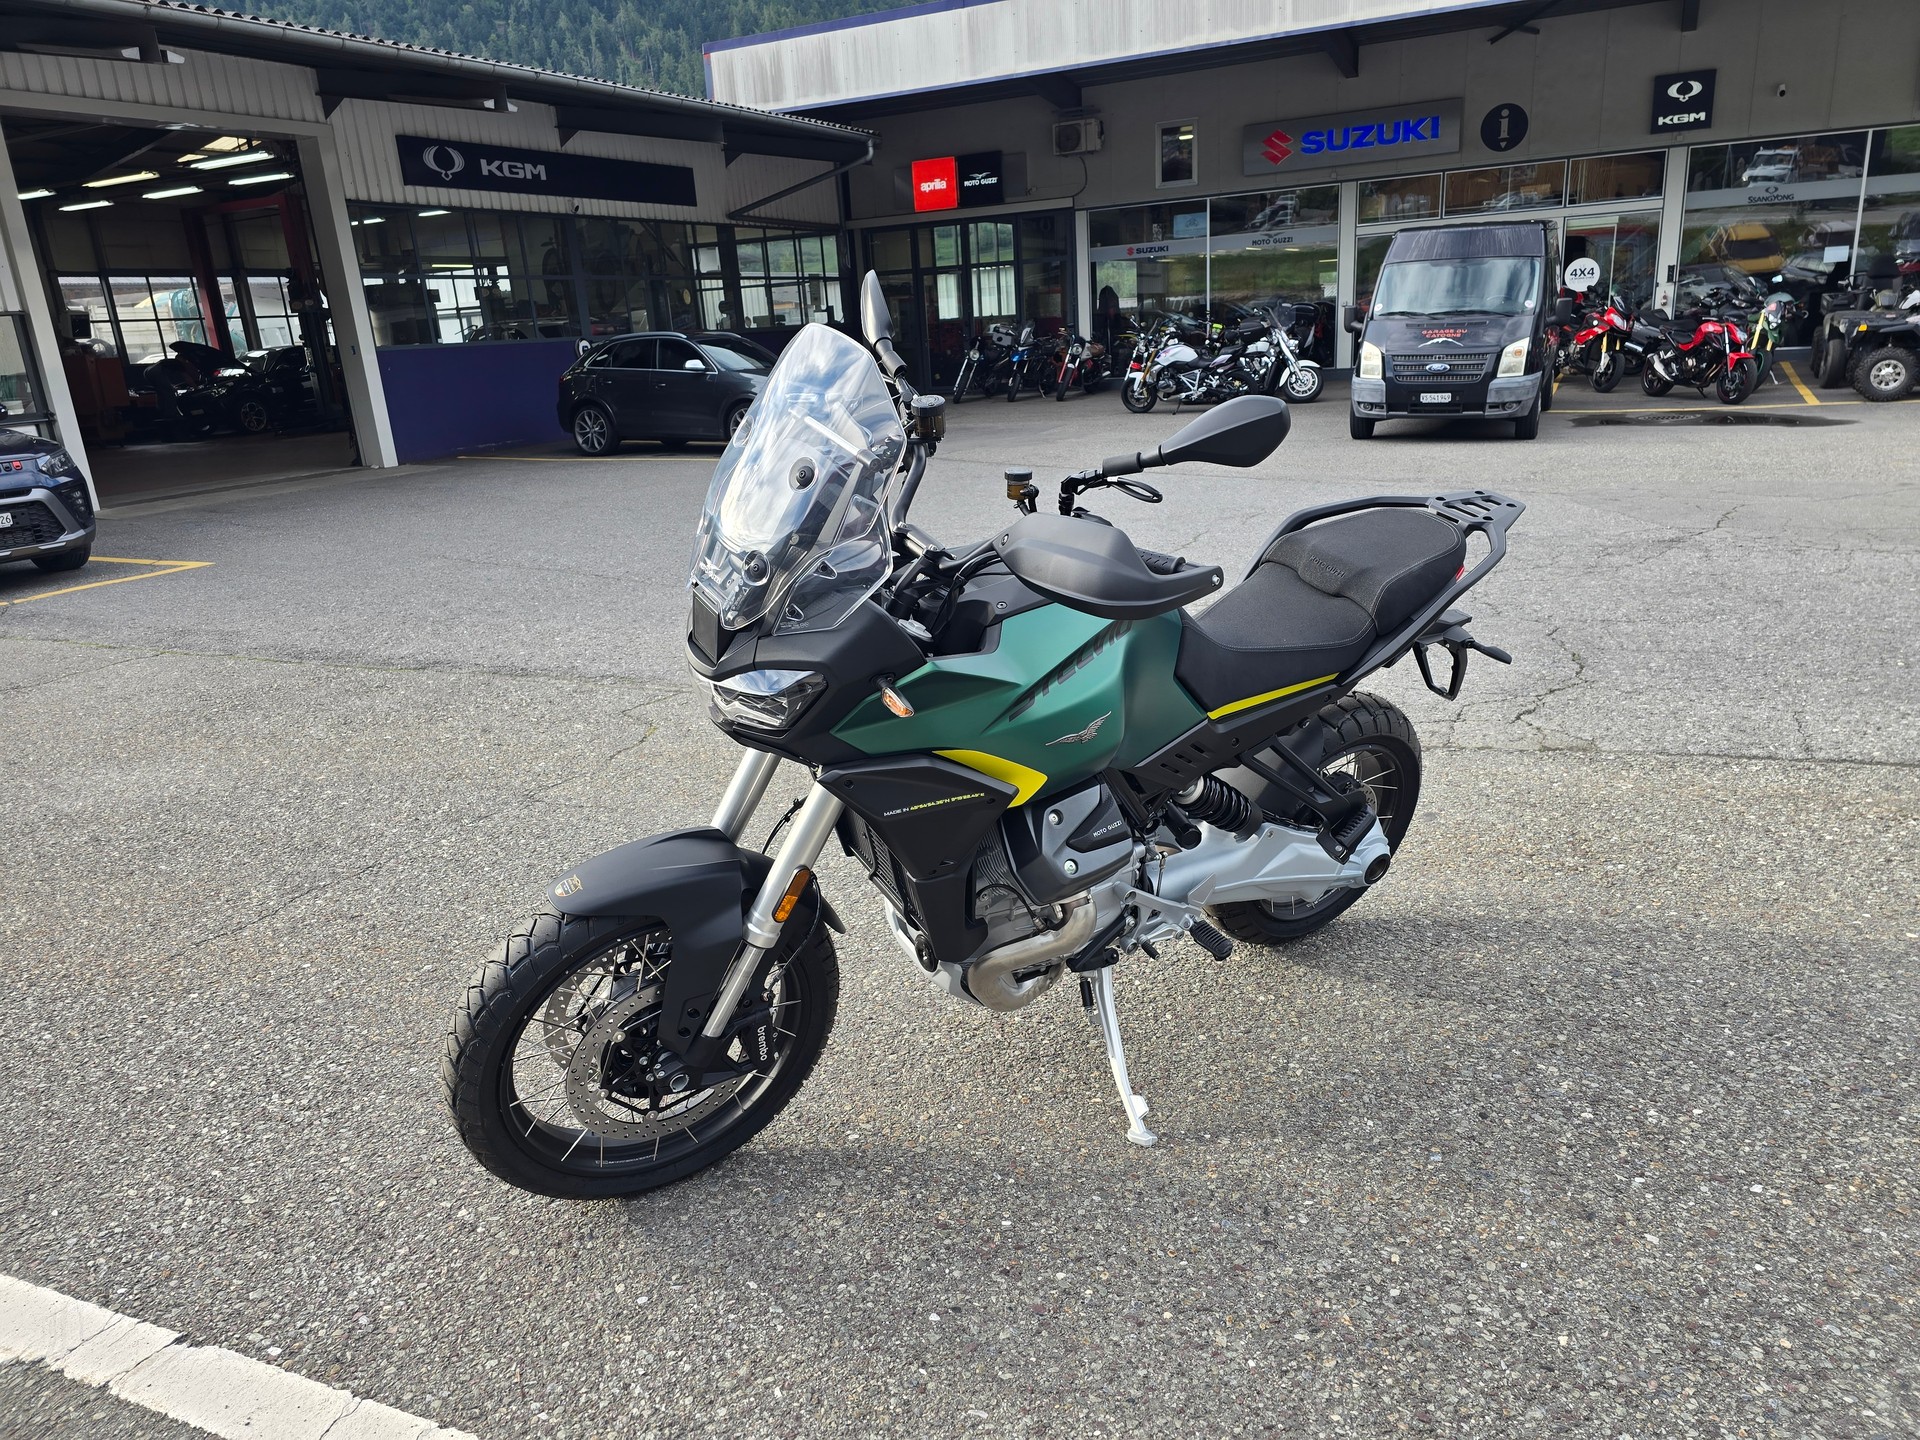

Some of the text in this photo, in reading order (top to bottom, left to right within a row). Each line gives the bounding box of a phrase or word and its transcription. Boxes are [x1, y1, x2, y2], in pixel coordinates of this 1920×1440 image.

[1657, 111, 1706, 126] KGM
[1300, 115, 1440, 154] SUZUKI
[480, 158, 547, 181] KGM
[920, 178, 947, 193] aprilia
[963, 177, 998, 187] MOTO GUZZI
[1251, 236, 1293, 246] MOTO GUZZI
[1135, 245, 1169, 255] SUZUKI
[1570, 267, 1595, 278] 4X4
[883, 808, 902, 817] MADE
[1092, 820, 1122, 838] MOTO GUZZI
[757, 1025, 769, 1061] brembo
